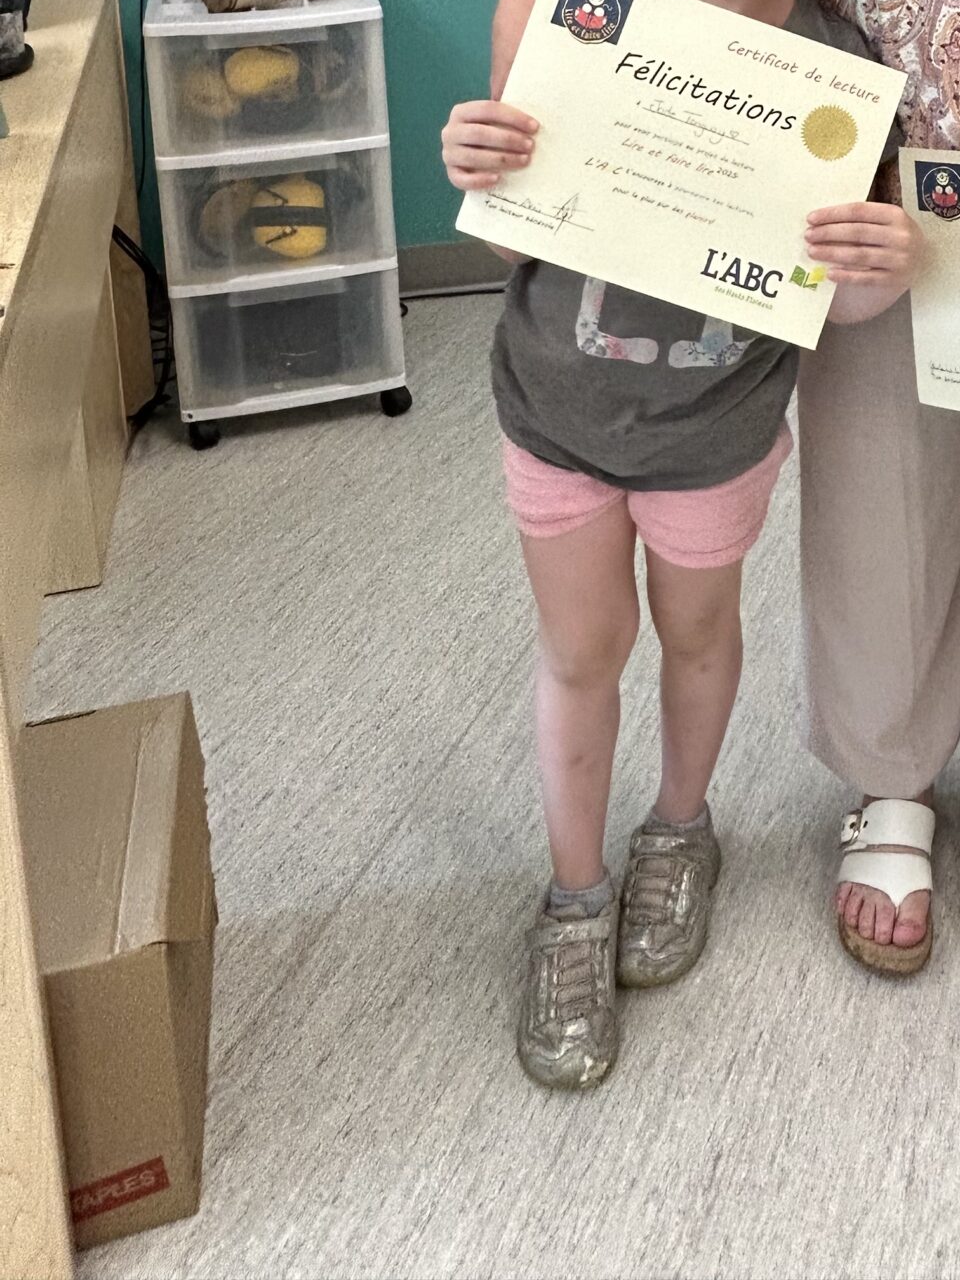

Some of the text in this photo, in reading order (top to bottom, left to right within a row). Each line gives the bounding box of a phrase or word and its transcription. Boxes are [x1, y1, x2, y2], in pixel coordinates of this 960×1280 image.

[615, 52, 797, 131] Félicitations
[727, 40, 881, 104] Certificat de lecture
[621, 138, 644, 152] Lire
[648, 148, 662, 158] et
[666, 153, 692, 168] faire
[700, 248, 784, 298] L'ABC
[73, 1170, 155, 1209] TAPLES
